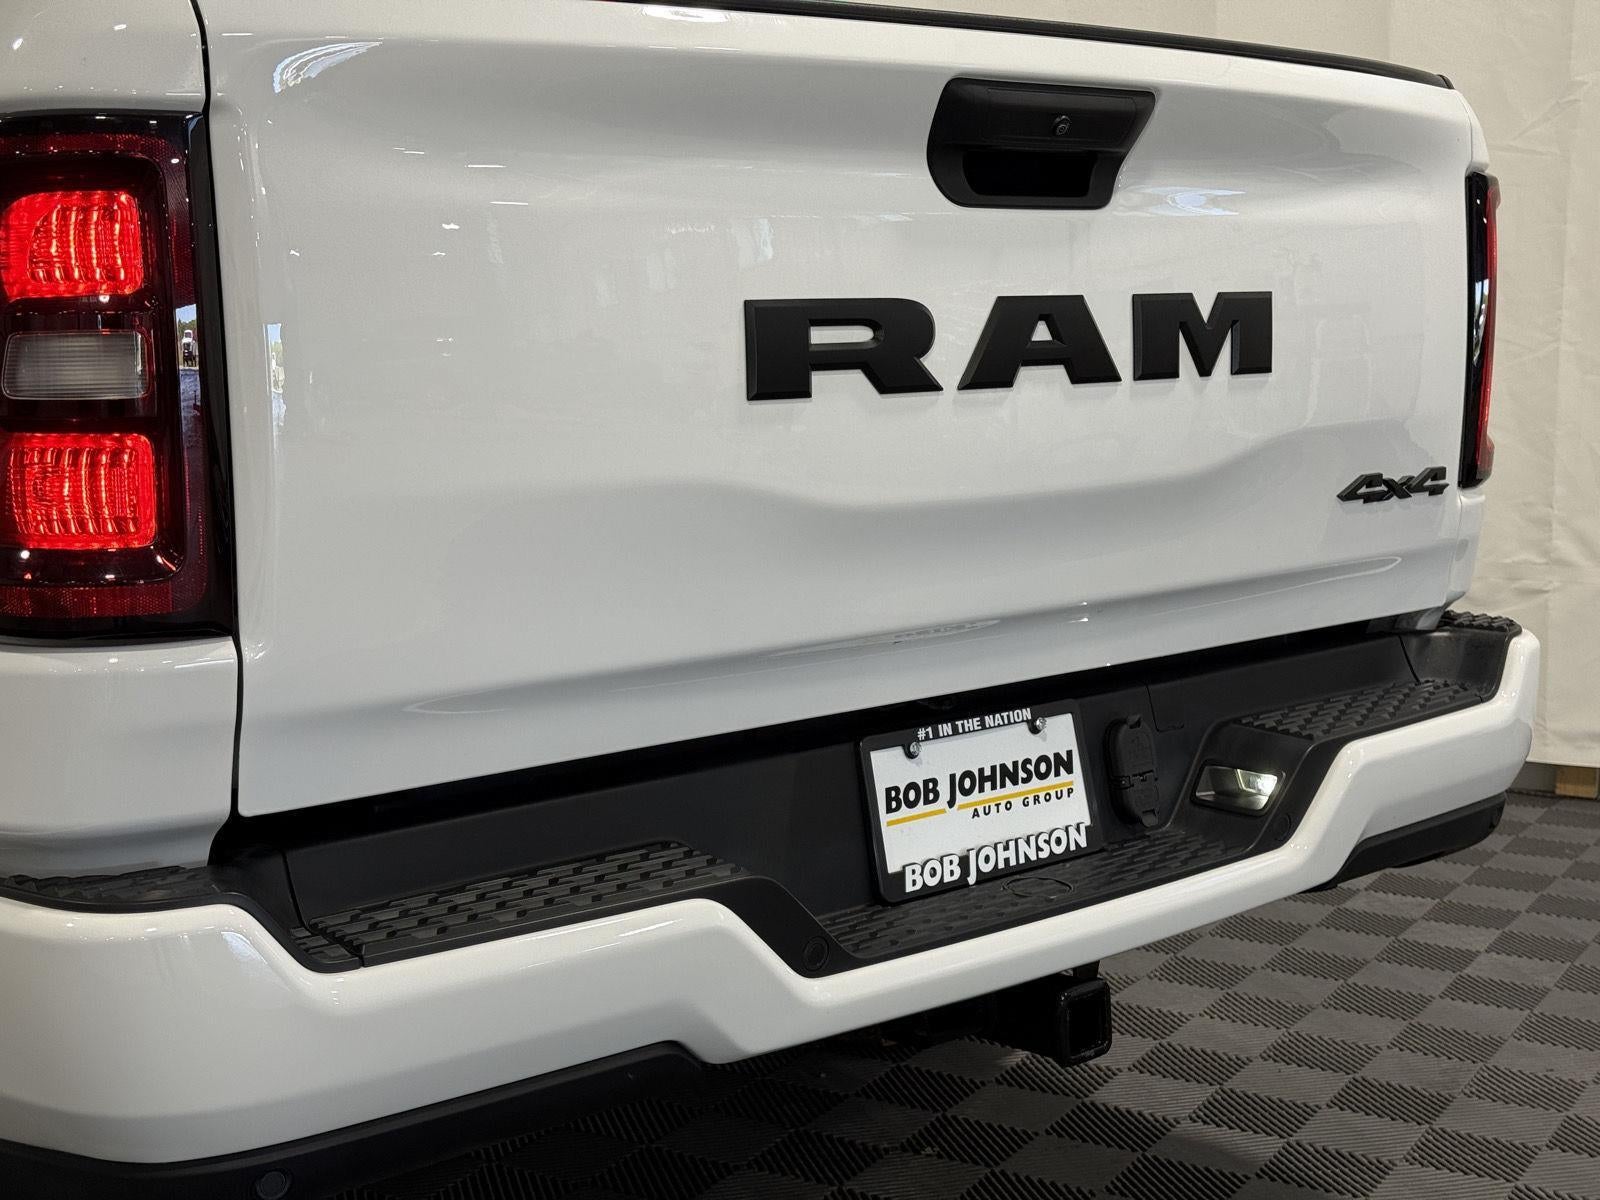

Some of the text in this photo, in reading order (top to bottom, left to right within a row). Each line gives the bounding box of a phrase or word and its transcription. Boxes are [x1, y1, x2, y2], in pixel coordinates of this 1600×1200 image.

[744, 291, 1273, 401] RAM
[917, 708, 1032, 740] #1 IN THE NATION
[885, 749, 1074, 814] BOB JOHNSON
[971, 787, 1074, 819] AUTO GROUP
[905, 823, 1088, 893] BOB JOHNSON
